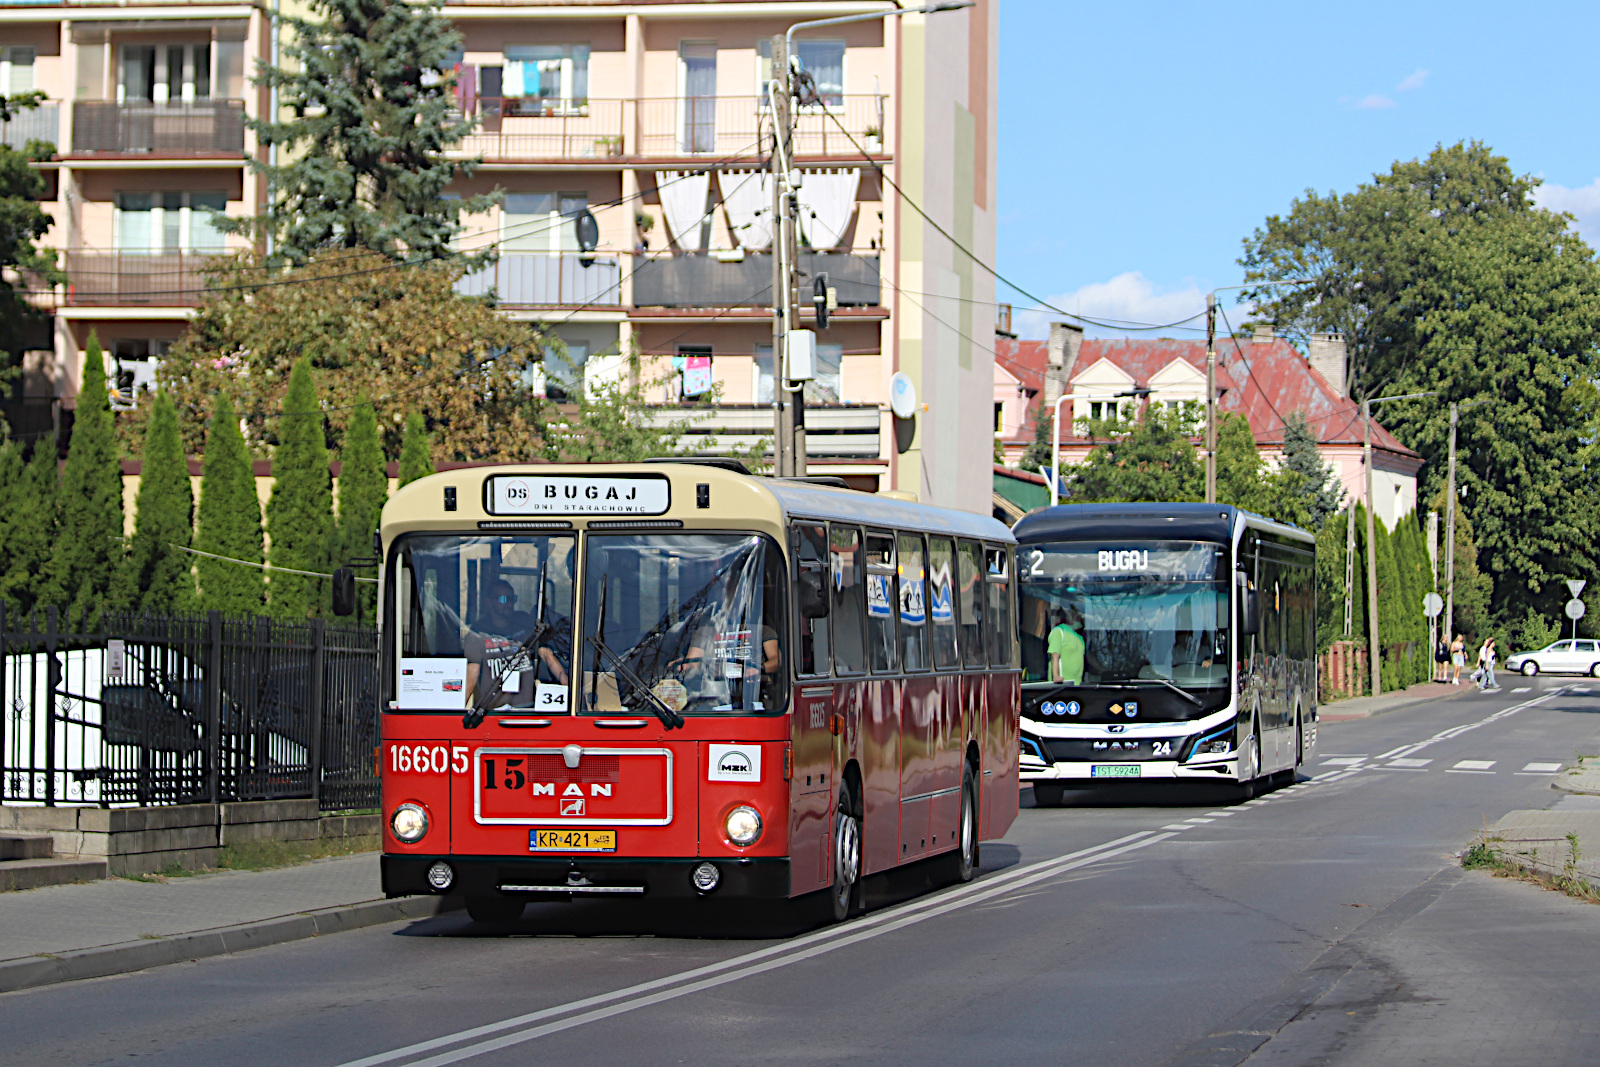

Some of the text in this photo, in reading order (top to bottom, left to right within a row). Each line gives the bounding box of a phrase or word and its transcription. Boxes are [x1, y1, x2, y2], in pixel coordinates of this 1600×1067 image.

[507, 487, 527, 499] DS
[544, 484, 637, 500] BUGAJ
[564, 504, 646, 513] STARACHOWIC
[1030, 550, 1044, 575] 2
[1098, 549, 1149, 571] BUGAJ
[542, 692, 565, 705] 34
[1093, 741, 1139, 751] MAN
[1152, 741, 1172, 756] 24
[390, 744, 469, 774] 16605
[484, 759, 525, 790] 15
[721, 764, 748, 772] MZK
[1096, 766, 1112, 776] TST
[1114, 766, 1139, 776] 5924A
[532, 783, 612, 797] MAN
[539, 832, 589, 847] KR 421
